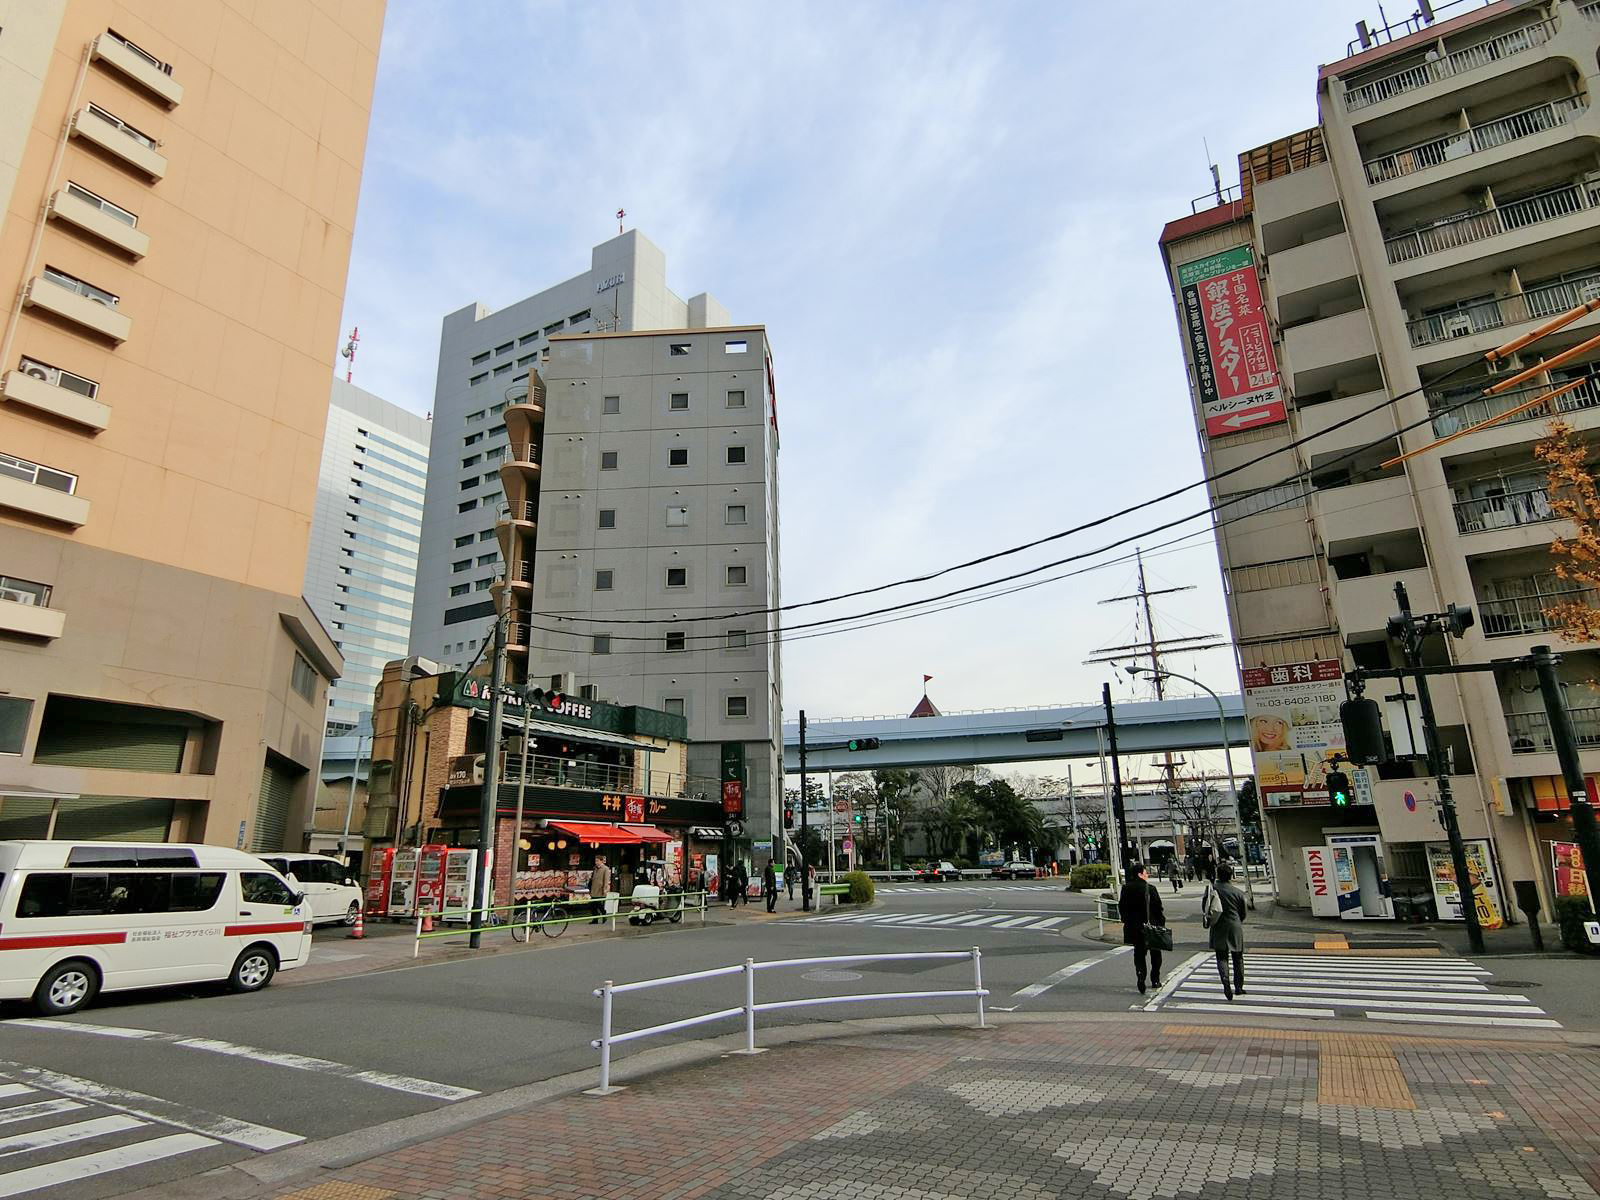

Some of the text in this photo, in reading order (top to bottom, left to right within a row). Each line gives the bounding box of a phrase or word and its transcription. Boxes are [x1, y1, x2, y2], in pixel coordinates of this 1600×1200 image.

[1231, 273, 1253, 317] 中国名菜
[1205, 279, 1241, 393] 銀座アスター
[1243, 329, 1256, 371] ノースタワー
[1270, 664, 1313, 684] 歯科
[1268, 694, 1337, 707] 03-6402-1180
[602, 794, 621, 811] 牛丼
[649, 799, 667, 814] カレー
[1307, 850, 1328, 896] KIRIN
[164, 928, 221, 939] 福祉プラザさくら川
